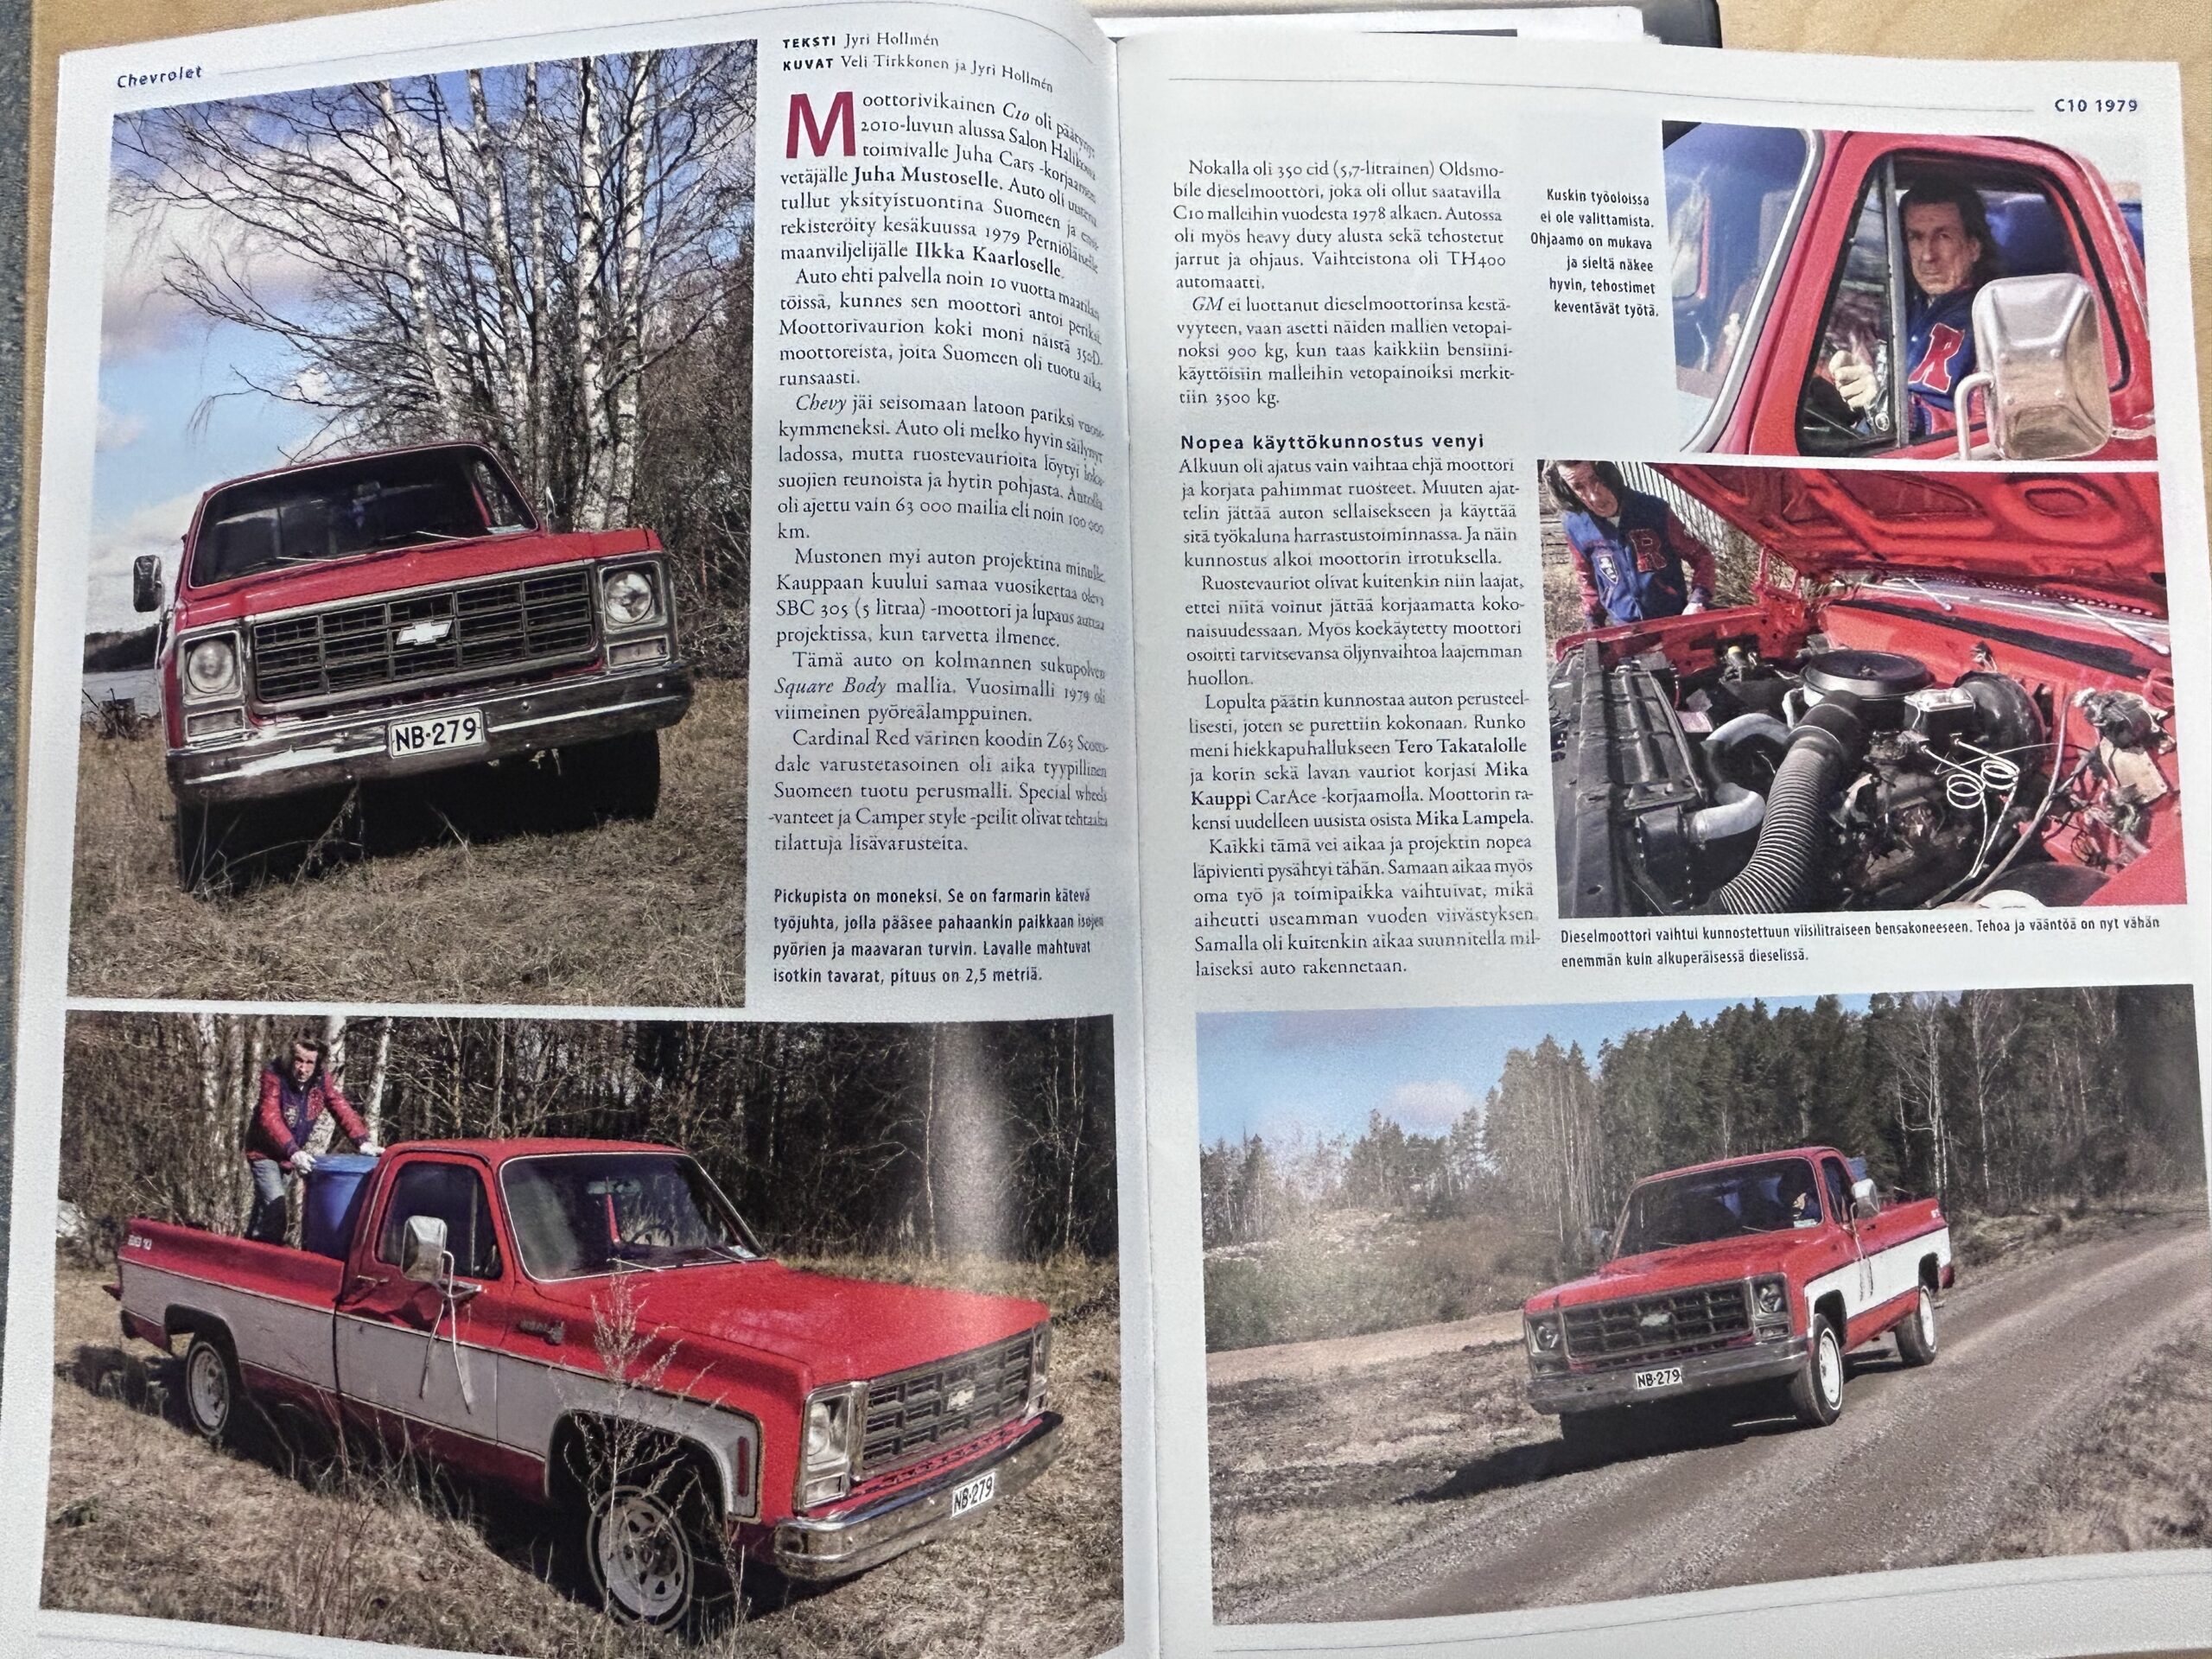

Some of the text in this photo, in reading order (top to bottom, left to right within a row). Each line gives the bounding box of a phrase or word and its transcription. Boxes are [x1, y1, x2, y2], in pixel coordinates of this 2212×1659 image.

[782, 31, 938, 51] TEKSTI Jyri Hollmén
[117, 65, 202, 89] Chevrolet
[783, 54, 1052, 93] KUVAT Veli Tirkkonen ja Jyri Hollmén
[1002, 102, 1030, 122] C10
[1035, 111, 1053, 131] oli
[2055, 99, 2139, 113] C10 1979
[861, 114, 1047, 153] 2010-luvun alussa Salon
[862, 140, 1034, 174] toimivalle Juha Cars
[1189, 159, 1504, 181] Nokalla oli 350 cid (5,7-litrainen) Oldsmo-
[779, 163, 1065, 207] vetäjälle Juha Mustoselle. Auto oli
[1547, 188, 1649, 207] Kuskin työoloissa
[781, 191, 830, 213] tullut
[838, 189, 984, 214] yksityistuontina
[993, 198, 1060, 230] Suomeen
[1173, 204, 1503, 225] C10 malleihin vuodesta 1978 alkaen. Autossa
[1540, 210, 1654, 228] ei ole valittamista.
[781, 214, 1020, 245] rekisteröity kesäkuussa 1979
[1530, 232, 1652, 250] Ohjaamo on mukava
[781, 239, 1065, 277] maanviljelijälle Ilkka Kaarloselle.
[1567, 255, 1654, 272] ja sieltä näkee
[1549, 276, 1656, 295] hyvin, tehostimet
[1554, 299, 1659, 319] keventävät työtä.
[1179, 387, 1280, 409] tiin 3500 kg.
[796, 392, 1074, 428] Chevy jäi seisomaan latoon pariksi
[1181, 433, 1484, 454] Nopea käyttökunnostus venyi
[778, 495, 1065, 524] oli ajettu vain 63 000 mailia eli noin
[777, 522, 810, 539] km.
[776, 599, 816, 617] SBC
[820, 601, 852, 623] 305
[876, 597, 926, 620] litraa)
[931, 603, 1012, 624] -moottori
[1014, 603, 1028, 625] ja
[1033, 602, 1074, 627] lupaus
[773, 675, 1090, 703] Square Body mallia. Vuosimalli 1979
[792, 728, 1073, 753] Cardinal Red värinen koodin Z63
[1191, 789, 1252, 811] Kauppi
[1255, 789, 1318, 805] CarAce
[1321, 785, 1425, 809] -korjaamolla.
[1427, 785, 1510, 802] Moottorin
[774, 887, 1090, 907] Pickupista on moneksi. Se on farmarin kätevä
[773, 912, 1074, 934] työjuhta, jolla pääsee pahaankin paikkaan
[1560, 916, 2160, 945] Dieselmoottori vaihtui kunnostettuun viisilitraiseen bensakoneeseen. Tehoa ja vääntöä on nyt vähän
[772, 938, 1090, 961] pyörien ja maavaran turvin. Lavalle mahtuvat
[1561, 947, 1808, 968] enemmän kuin alkuperäisessä dieselissä.
[773, 966, 1042, 987] isotkin tavarat, pituus on 2,5 metriä.
[1196, 957, 1407, 976] laiseksi auto rakennetaan.
